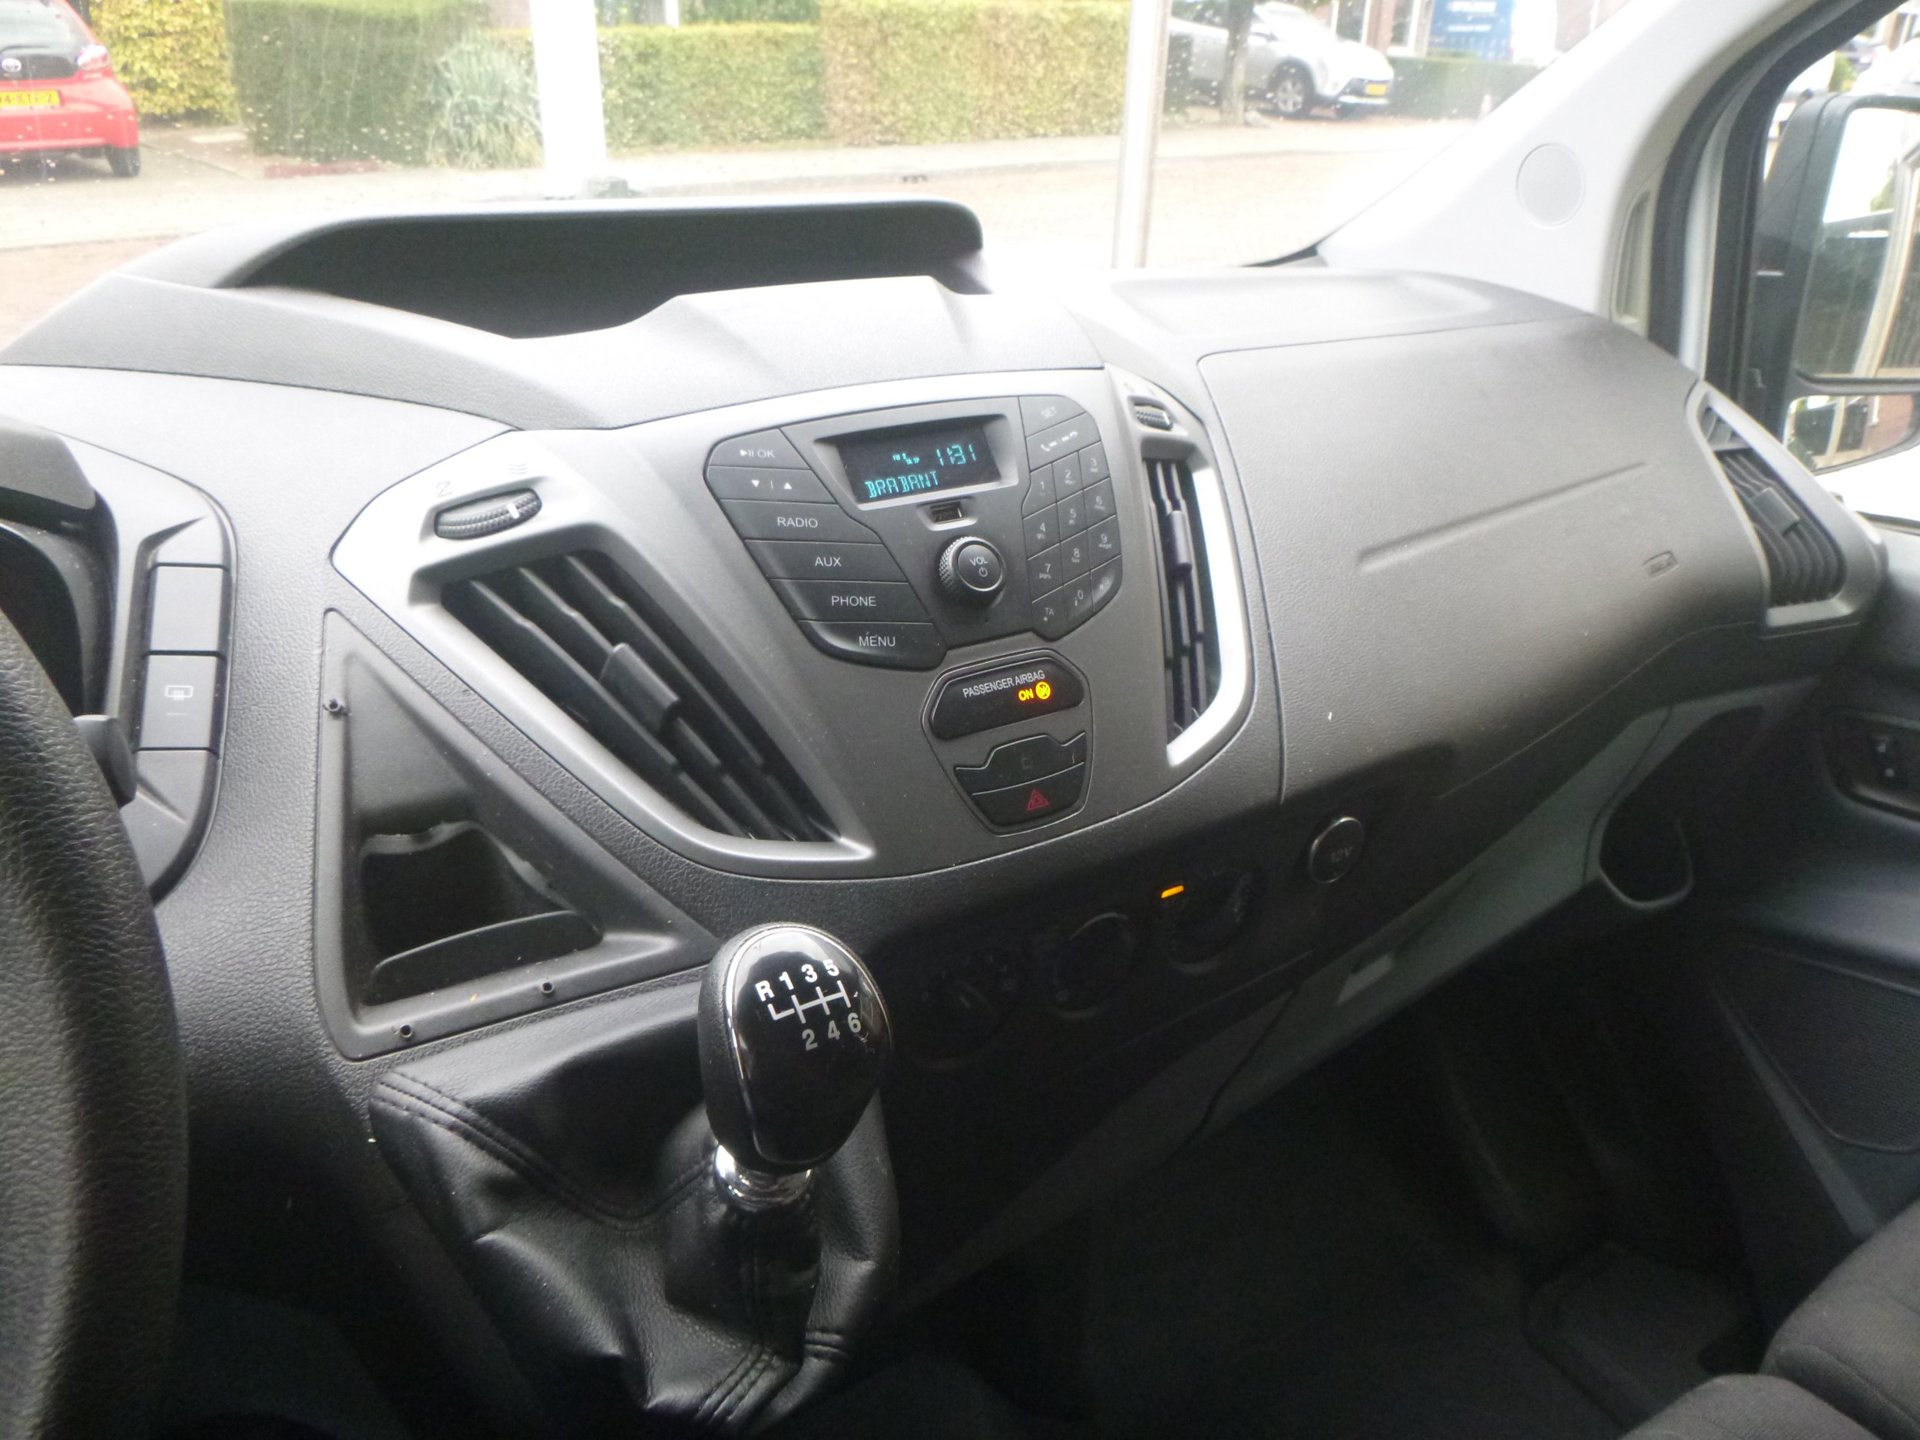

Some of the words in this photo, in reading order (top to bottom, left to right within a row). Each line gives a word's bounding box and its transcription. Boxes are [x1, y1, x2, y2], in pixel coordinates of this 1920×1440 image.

[757, 449, 776, 458] OK
[777, 516, 819, 528] RADIO
[815, 556, 842, 567] AUX
[969, 556, 988, 566] VOL
[831, 595, 877, 607] PHONE
[858, 635, 897, 647] MENU
[962, 677, 1015, 699] PASSENGER
[1015, 669, 1046, 686] AIRBAG
[1018, 688, 1034, 702] ON
[755, 980, 775, 1002] R
[779, 971, 794, 990] 1
[801, 963, 818, 983] 3
[823, 959, 840, 977] 5
[802, 1028, 818, 1051] 2
[827, 1019, 840, 1040] 4
[847, 1012, 861, 1033] 6
